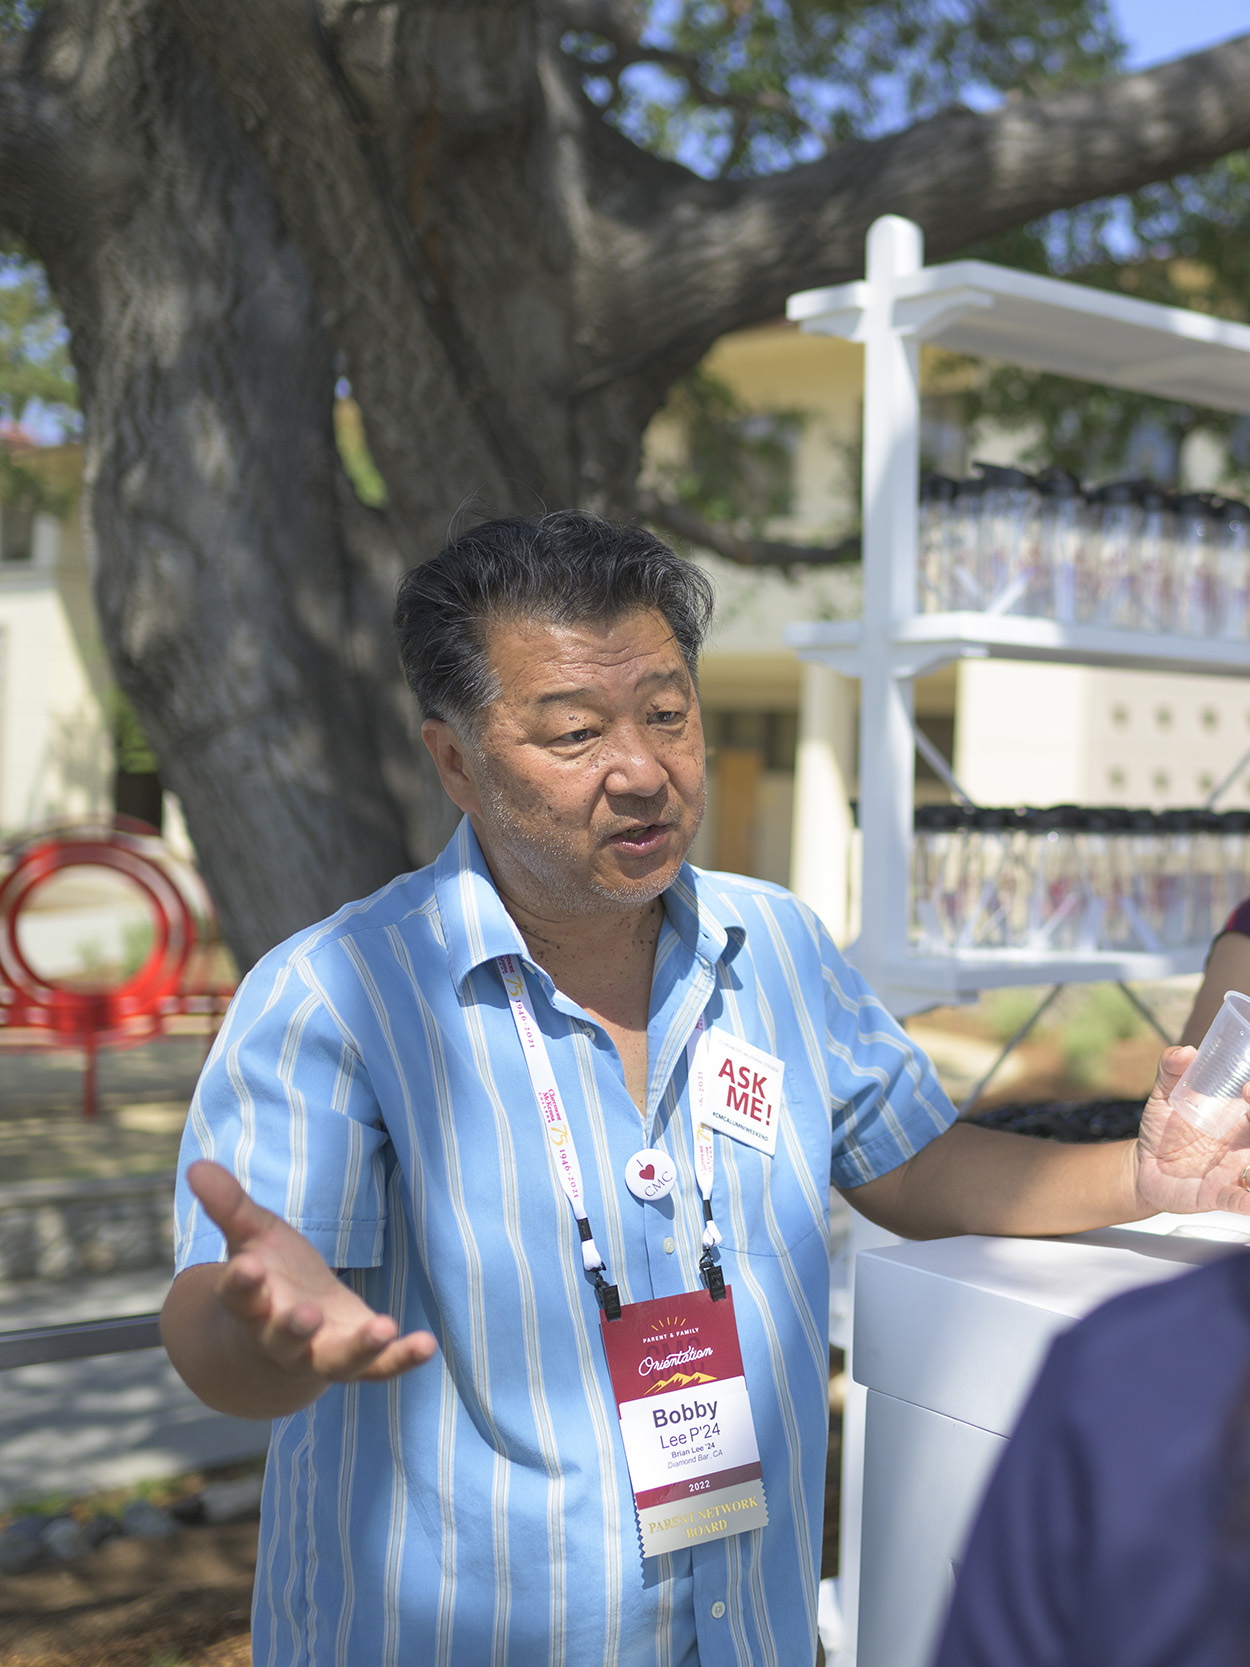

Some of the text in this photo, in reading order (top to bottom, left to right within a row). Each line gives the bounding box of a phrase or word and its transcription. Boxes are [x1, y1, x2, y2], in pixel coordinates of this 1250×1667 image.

[505, 976, 524, 997] 75
[718, 1058, 767, 1099] ASK
[542, 1091, 555, 1122] McKenna
[548, 1088, 561, 1121] Claremont
[726, 1085, 772, 1126] ME!
[550, 1124, 568, 1146] 75
[636, 1159, 644, 1168] I
[645, 1170, 673, 1197] CMC
[643, 1333, 667, 1343] PARENT
[676, 1327, 699, 1337] FAMILY
[638, 1345, 713, 1376] Orientation
[652, 1400, 718, 1428] Bobby
[660, 1422, 720, 1449] Lee P'24
[668, 1456, 697, 1469] Diamond
[713, 1449, 723, 1458] CA
[671, 1449, 690, 1458] Brian
[691, 1445, 704, 1454] Lee
[689, 1479, 710, 1492] 2022
[649, 1496, 758, 1534] PARENT NETWORK
[686, 1519, 728, 1539] BOARD
